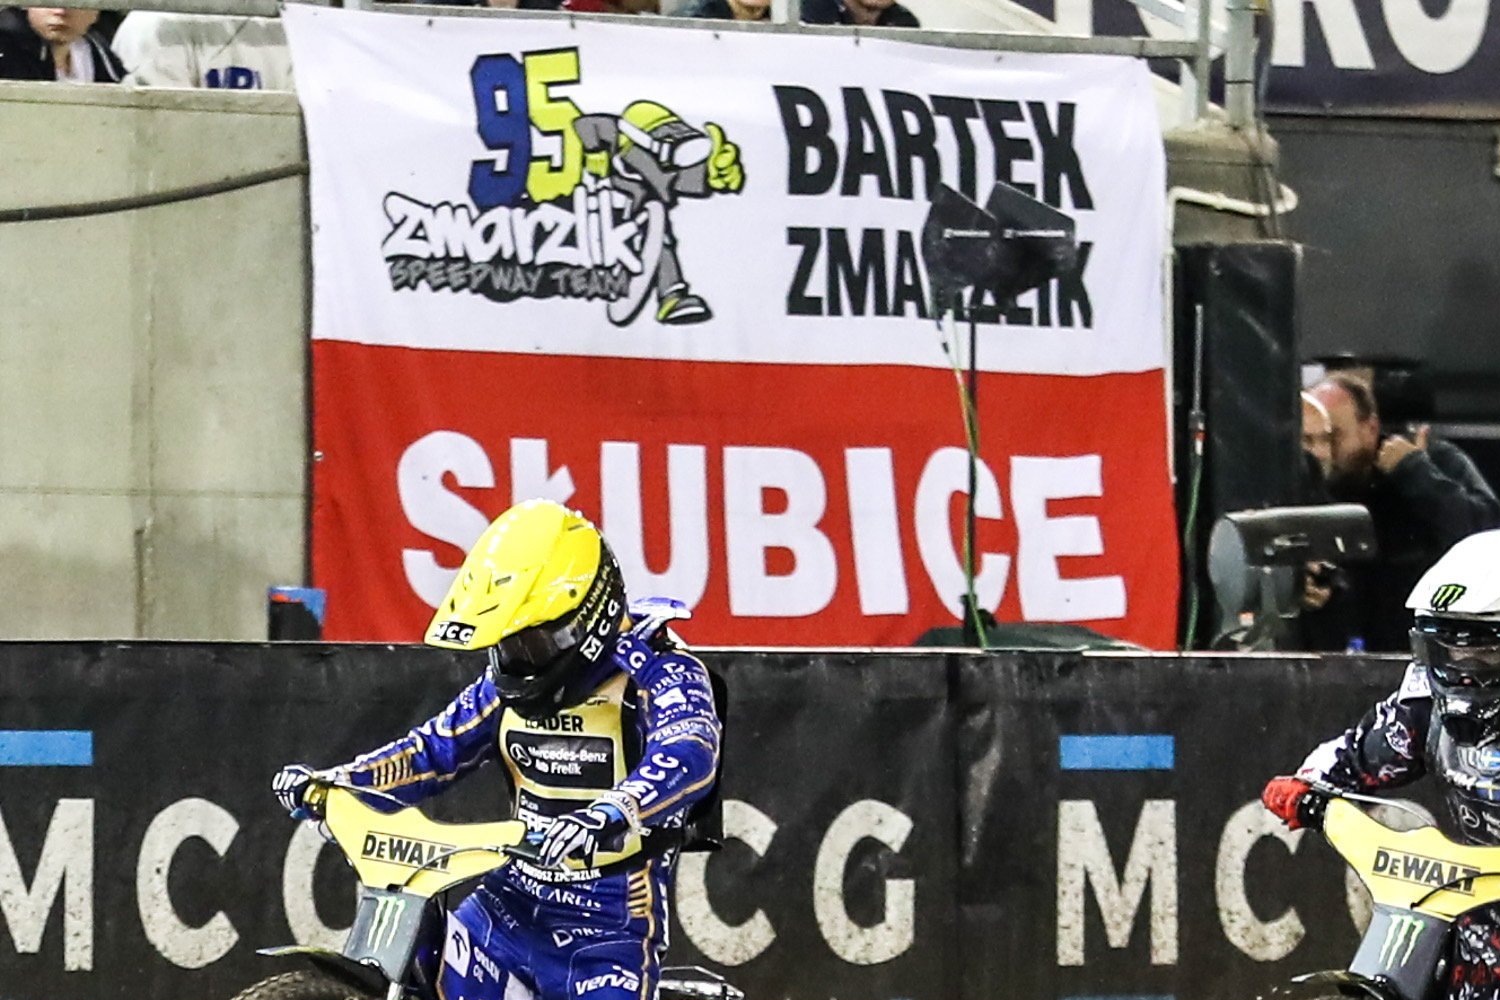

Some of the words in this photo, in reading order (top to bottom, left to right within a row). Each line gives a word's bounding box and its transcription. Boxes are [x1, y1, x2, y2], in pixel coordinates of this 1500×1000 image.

[467, 46, 582, 206] 95
[773, 85, 1094, 211] BARTEK
[388, 260, 543, 294] SPEEDWAY
[551, 267, 630, 297] TEAM
[580, 599, 621, 661] MCG
[528, 746, 607, 763] Mercedes-Benz
[675, 799, 916, 967] CG
[575, 971, 639, 996] verva
